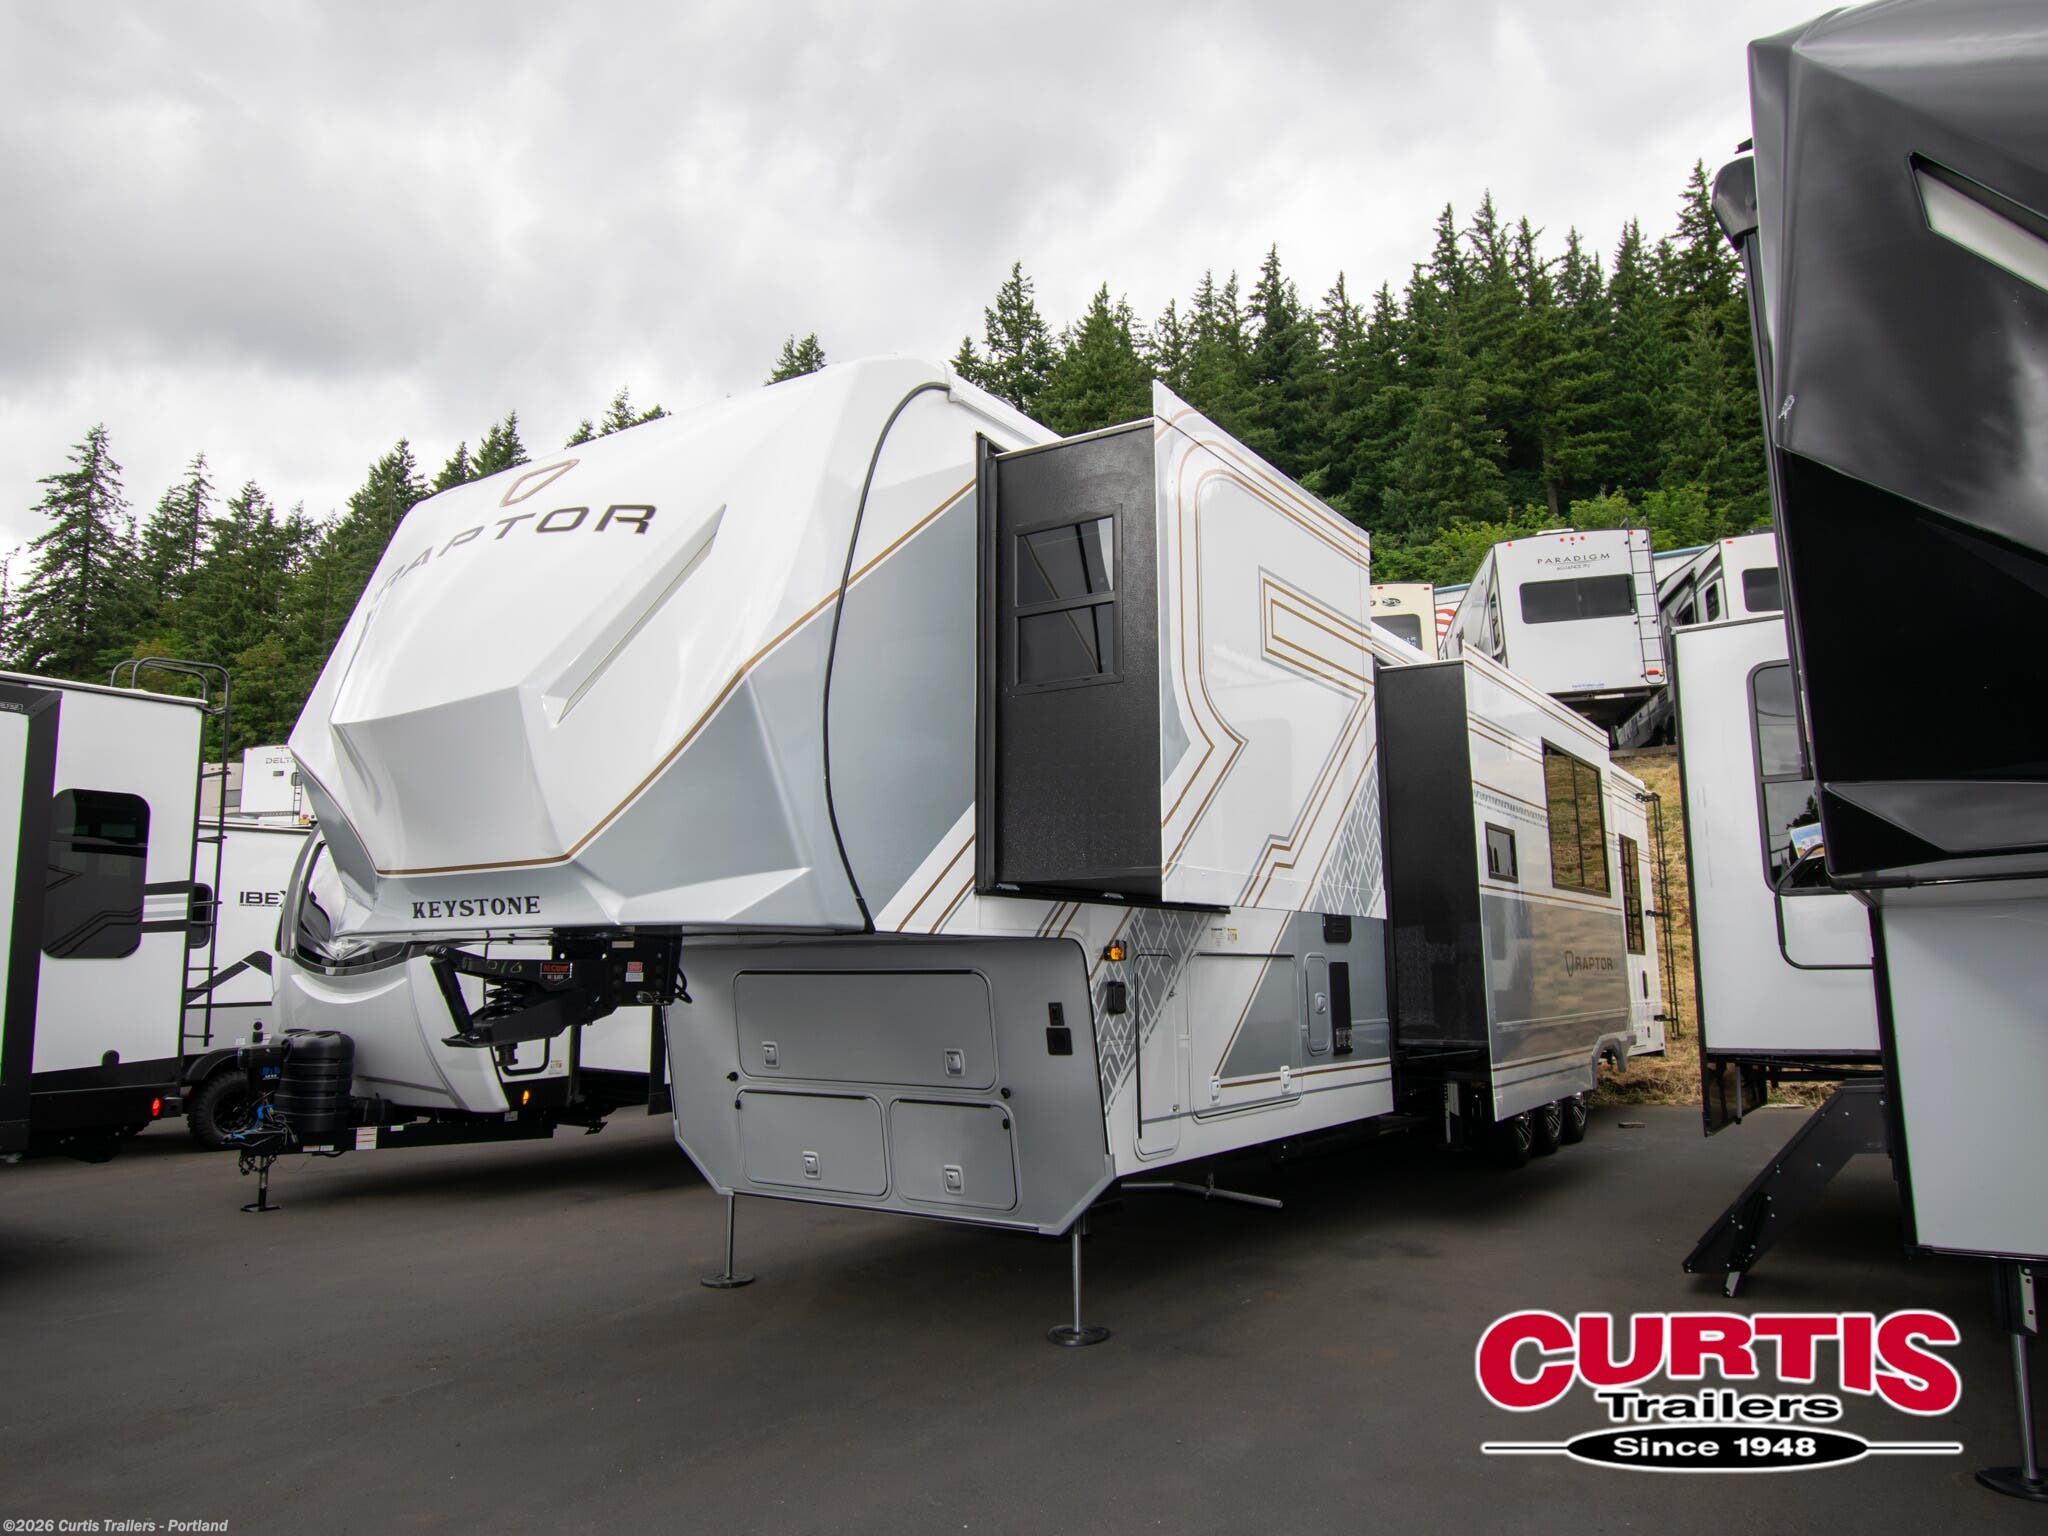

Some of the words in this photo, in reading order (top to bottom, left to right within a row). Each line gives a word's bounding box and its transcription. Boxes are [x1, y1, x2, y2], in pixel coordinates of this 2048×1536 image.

[1537, 553, 1610, 564] PARADIGM
[411, 896, 541, 919] KEYSTONE
[1575, 956, 1613, 970] RAPTOR
